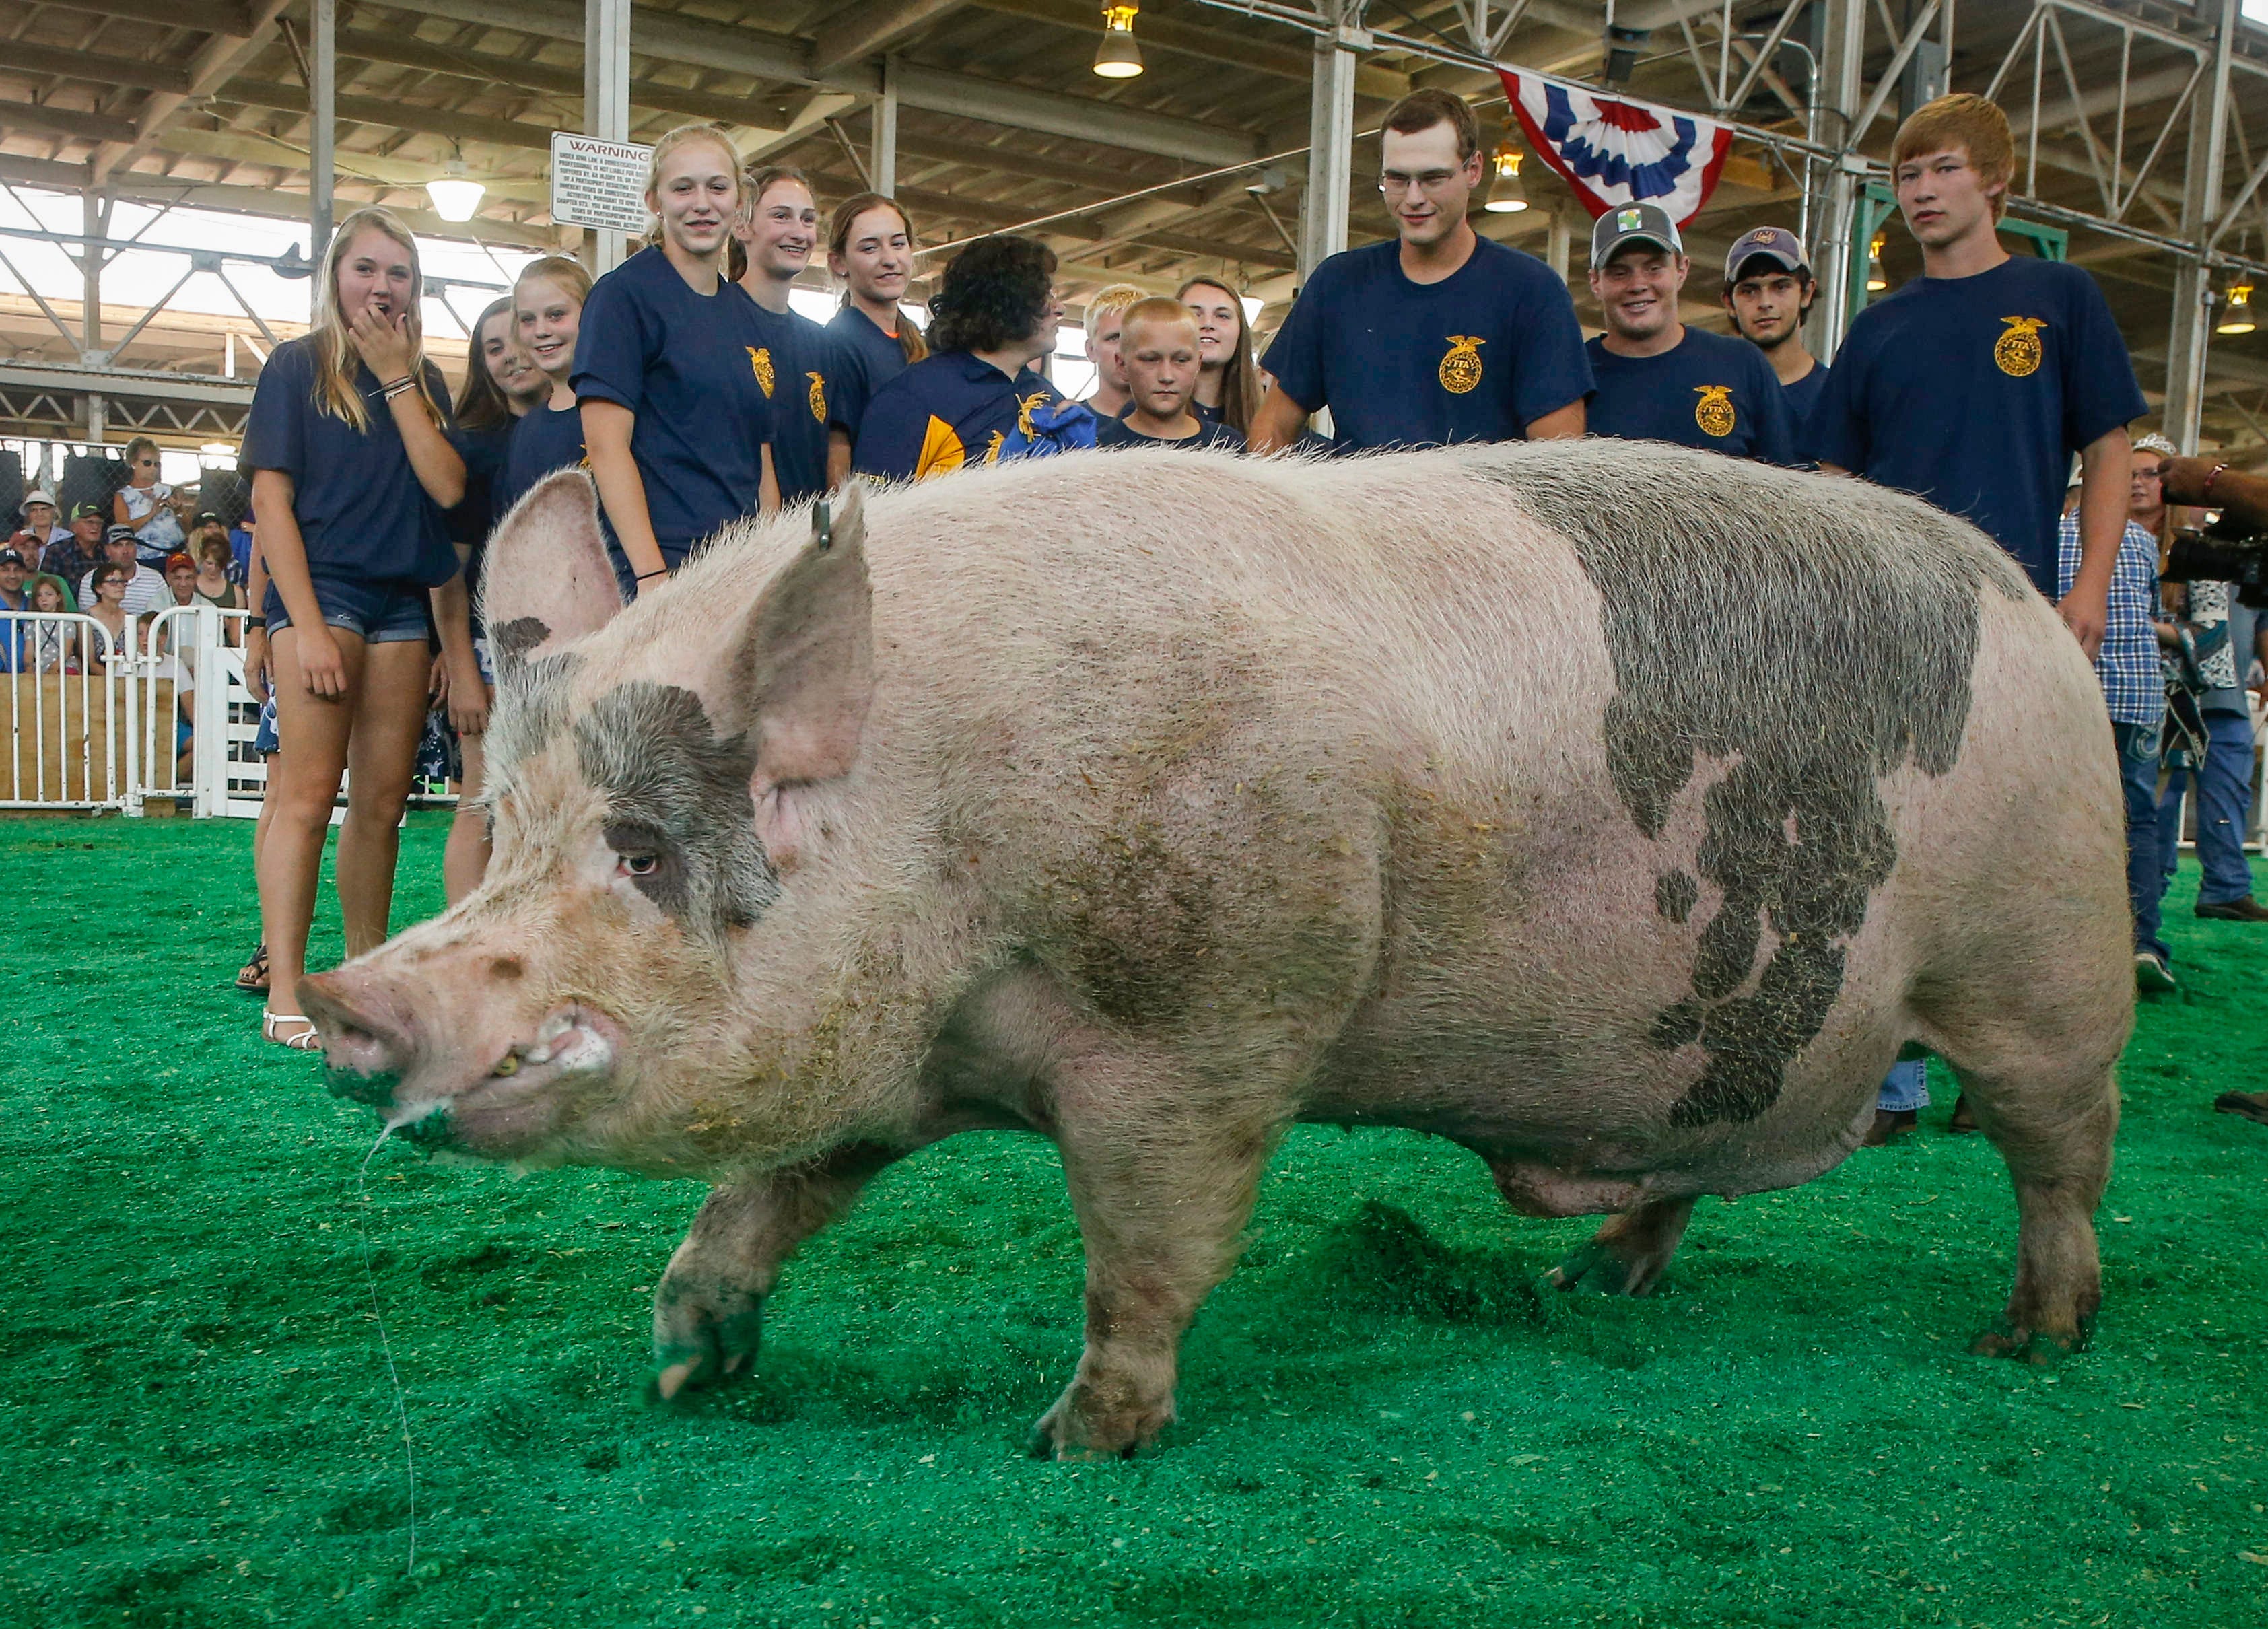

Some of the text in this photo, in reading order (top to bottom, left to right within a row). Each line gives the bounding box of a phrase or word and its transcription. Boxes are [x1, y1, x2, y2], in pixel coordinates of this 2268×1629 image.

[570, 140, 649, 161] WARNING
[559, 160, 592, 170] PROFESSIONAL
[605, 160, 637, 170] DOMESTICATED
[560, 167, 582, 176] SUFFERED
[560, 182, 582, 191] INHERENT
[576, 177, 605, 187] PARTICIPANT
[606, 182, 629, 190] RESULTING
[594, 195, 618, 204] PURSUANT
[557, 197, 578, 205] CHAPTER
[612, 205, 635, 214] ASSUMING
[594, 210, 626, 220] PARTICIPATING
[571, 215, 644, 230] DOMESTICATED ANIMAL ACTIVITY
[2012, 340, 2030, 350] FFA
[1453, 360, 1470, 368] FFA
